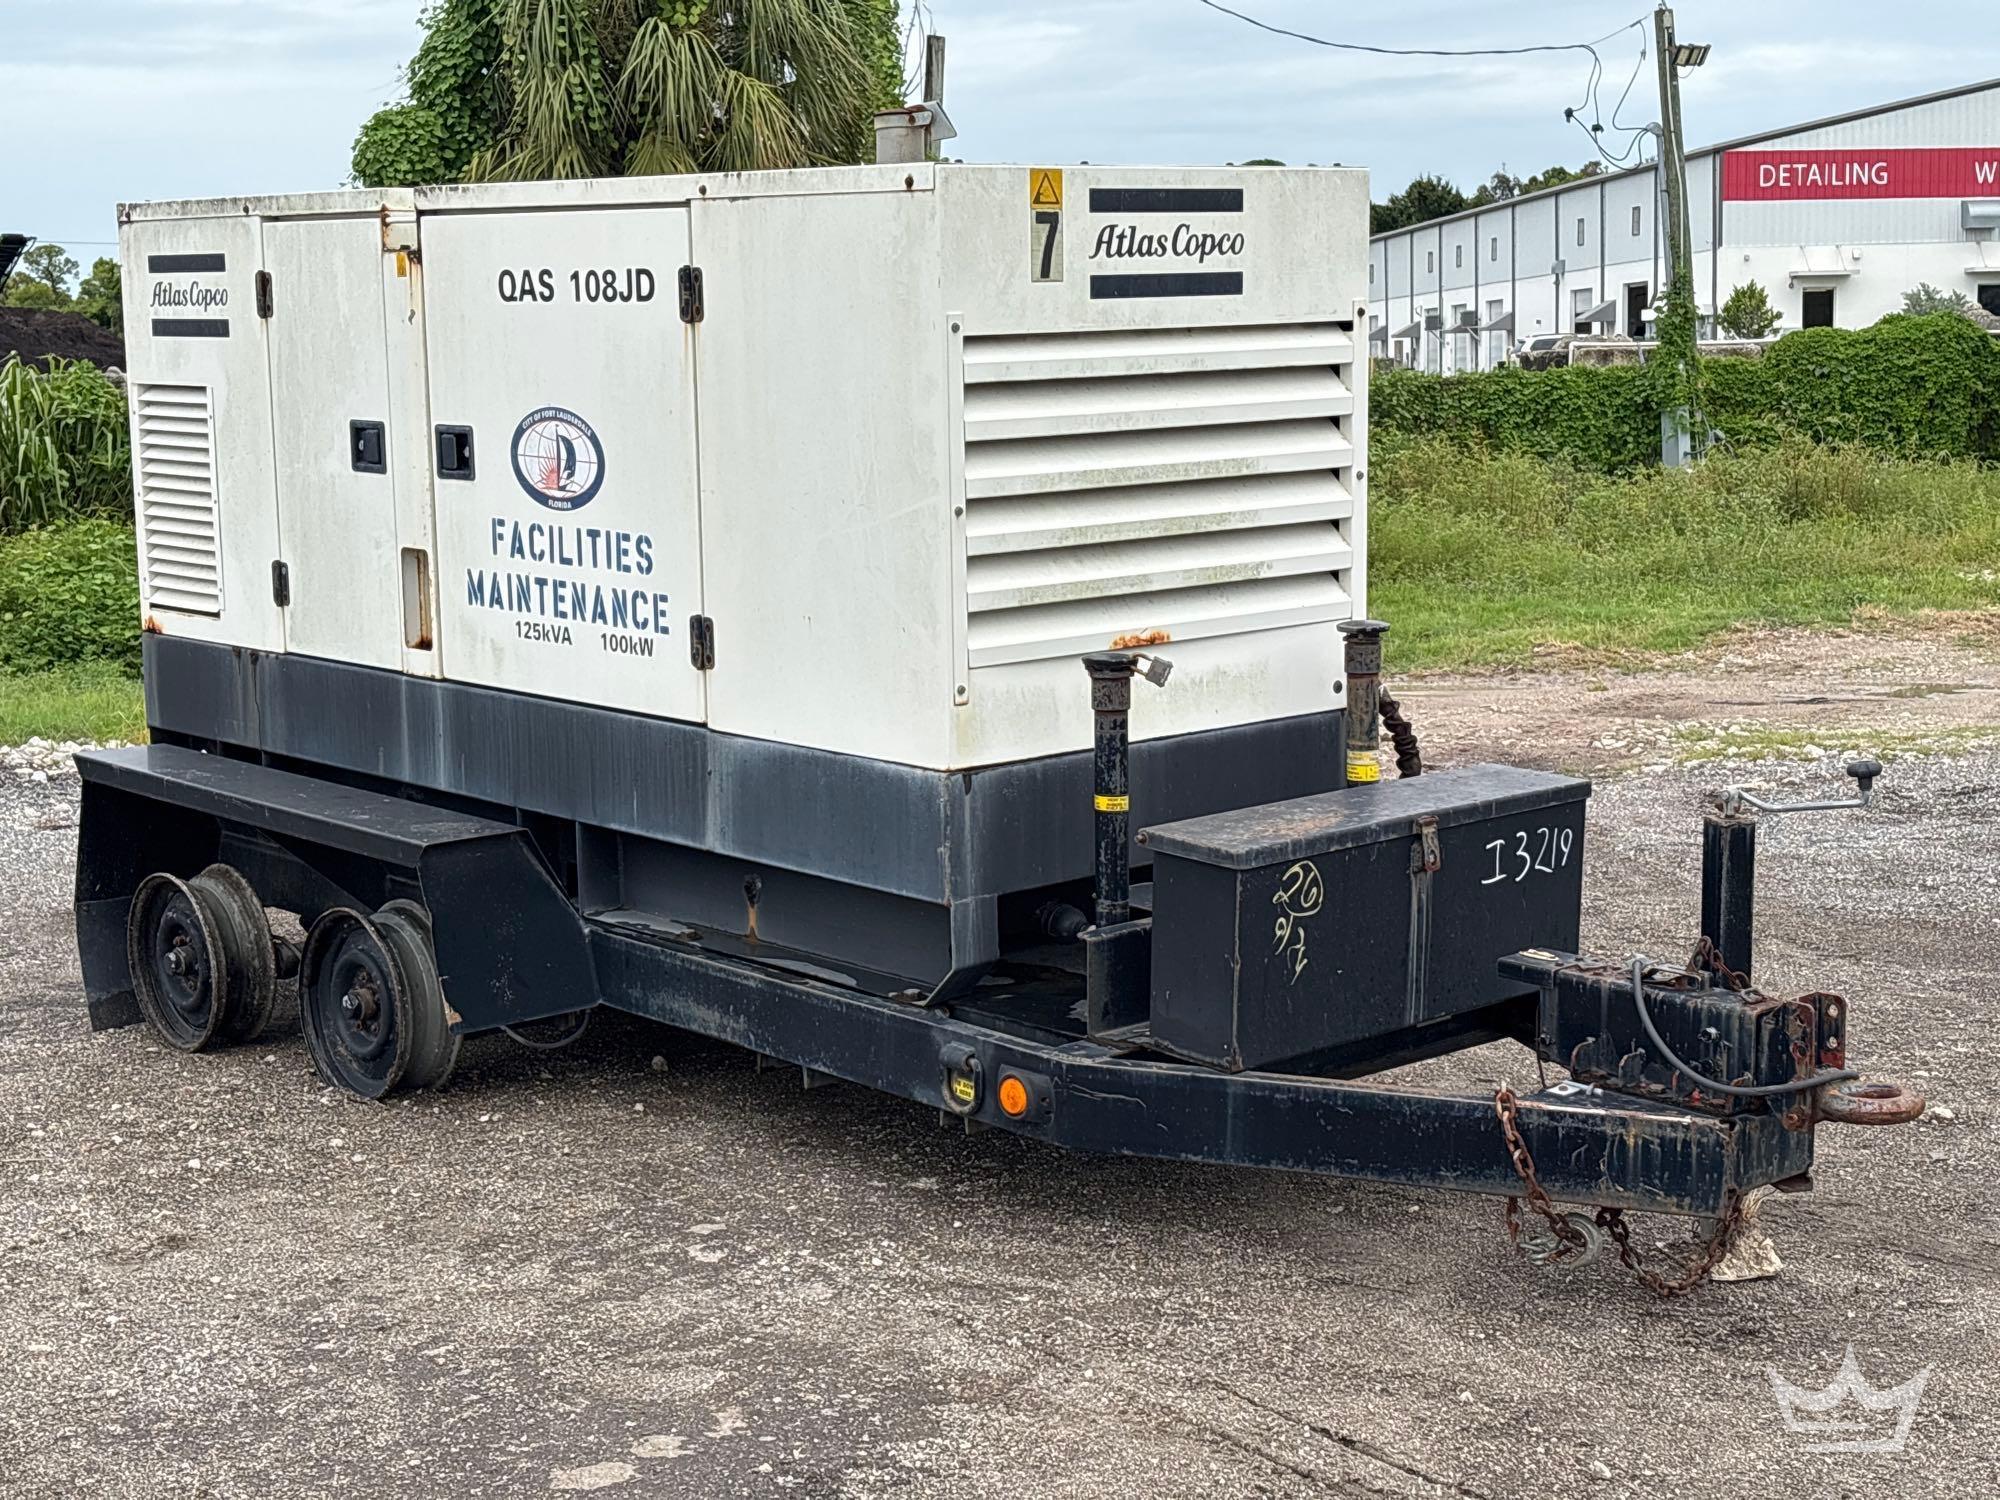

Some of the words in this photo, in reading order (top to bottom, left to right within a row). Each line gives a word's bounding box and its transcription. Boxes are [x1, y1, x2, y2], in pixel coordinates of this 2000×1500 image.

[1759, 161, 1888, 188] DETAILING
[1035, 211, 1060, 279] 7
[1088, 223, 1168, 259] Atlas
[1171, 223, 1245, 264] Copco
[150, 280, 188, 308] Atlas
[189, 280, 229, 313] Copco
[498, 268, 555, 303] QAS
[569, 267, 656, 303] 108JD
[522, 415, 534, 430] CITY
[548, 498, 573, 509] FLORIDA
[491, 517, 654, 576] FACILITIES
[466, 568, 670, 635] MAINTENANCE
[515, 620, 573, 646] 125kVA
[601, 632, 654, 658] 100kW
